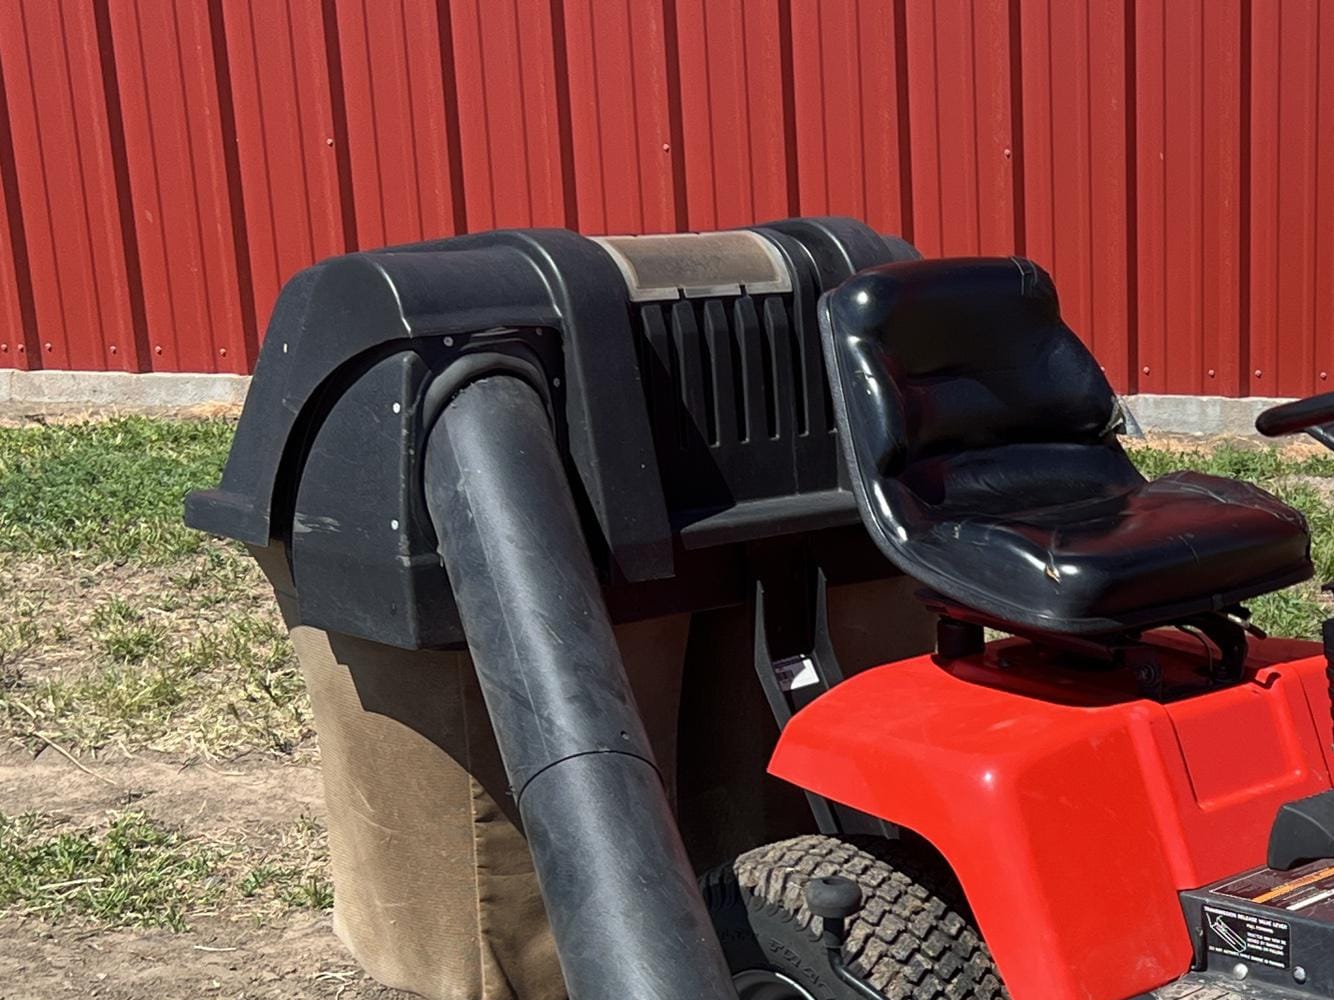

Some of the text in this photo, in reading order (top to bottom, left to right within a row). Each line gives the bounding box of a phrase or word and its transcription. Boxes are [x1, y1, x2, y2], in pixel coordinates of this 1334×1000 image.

[1237, 913, 1257, 922] RELEASE
[1258, 918, 1271, 926] VALVE
[1272, 922, 1287, 930] LEVER
